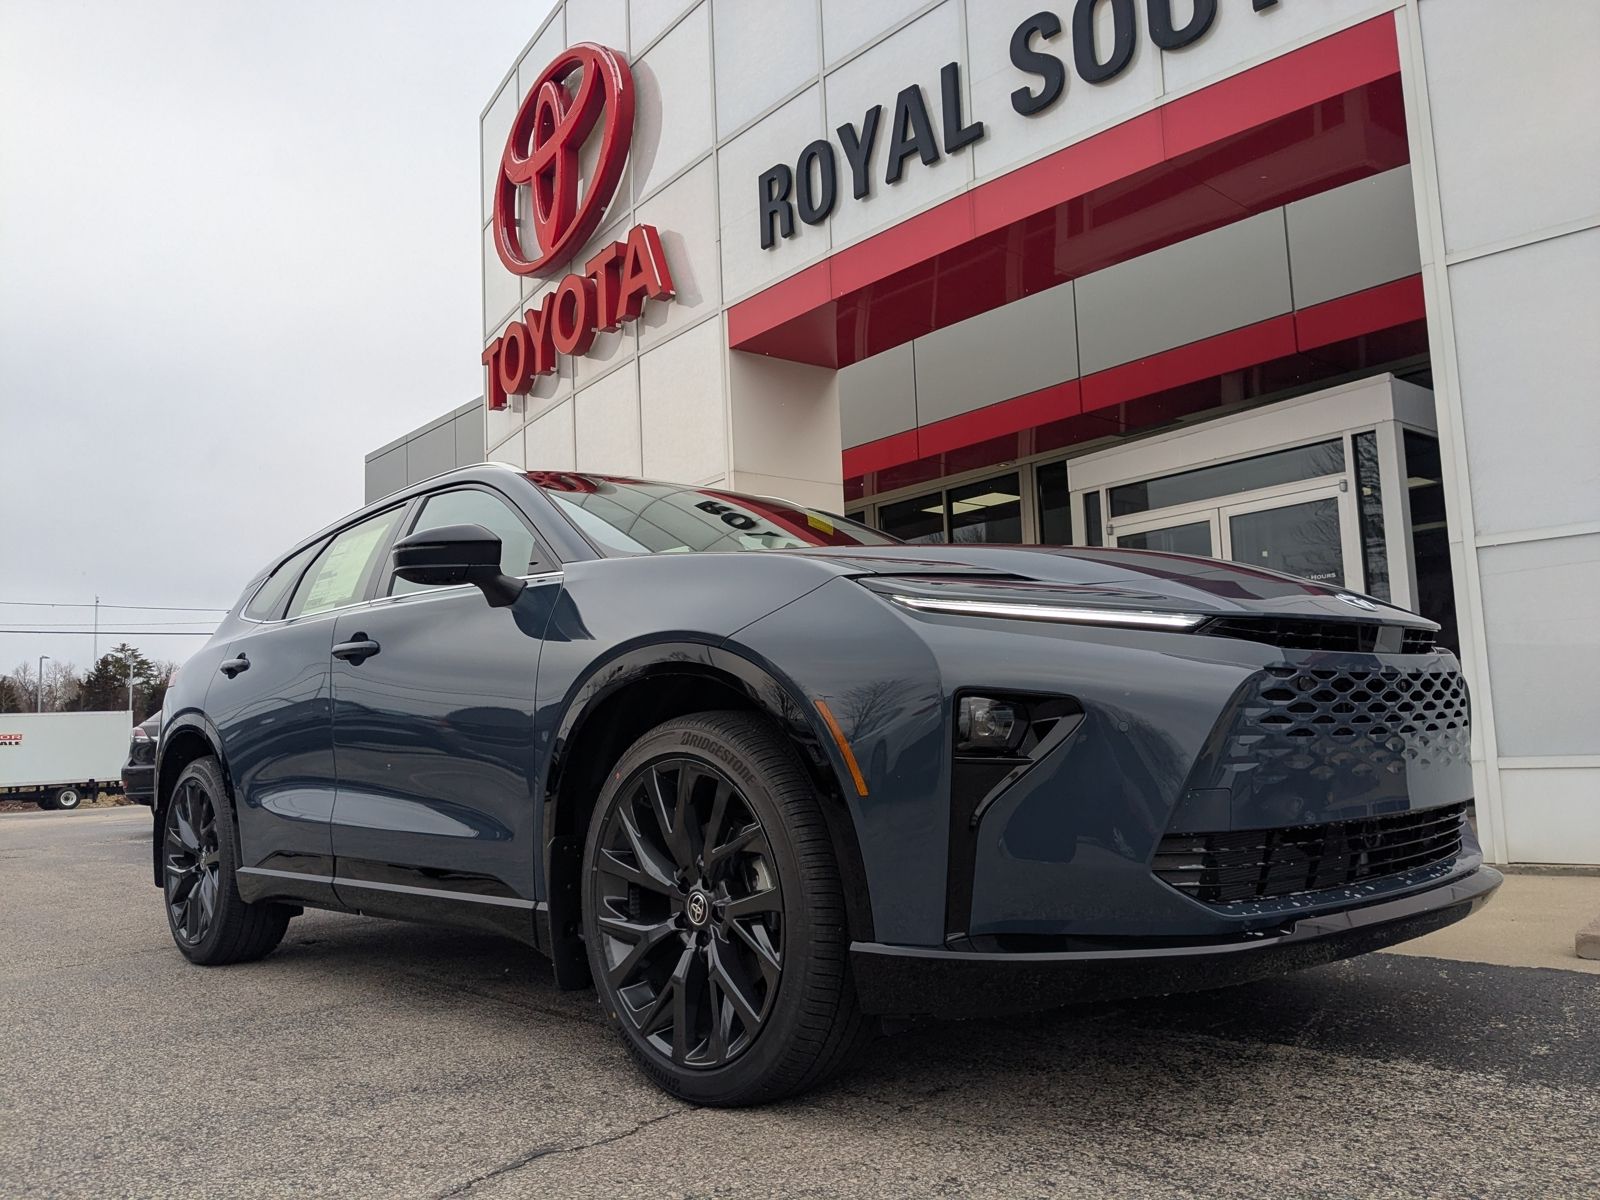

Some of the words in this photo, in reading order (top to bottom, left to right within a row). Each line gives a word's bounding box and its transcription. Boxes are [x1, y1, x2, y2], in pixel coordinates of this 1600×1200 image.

[758, 62, 983, 250] ROYAL
[1010, 0, 1278, 118] SOU
[482, 223, 675, 411] TOYOTA
[680, 731, 758, 786] BRIDGESTONE
